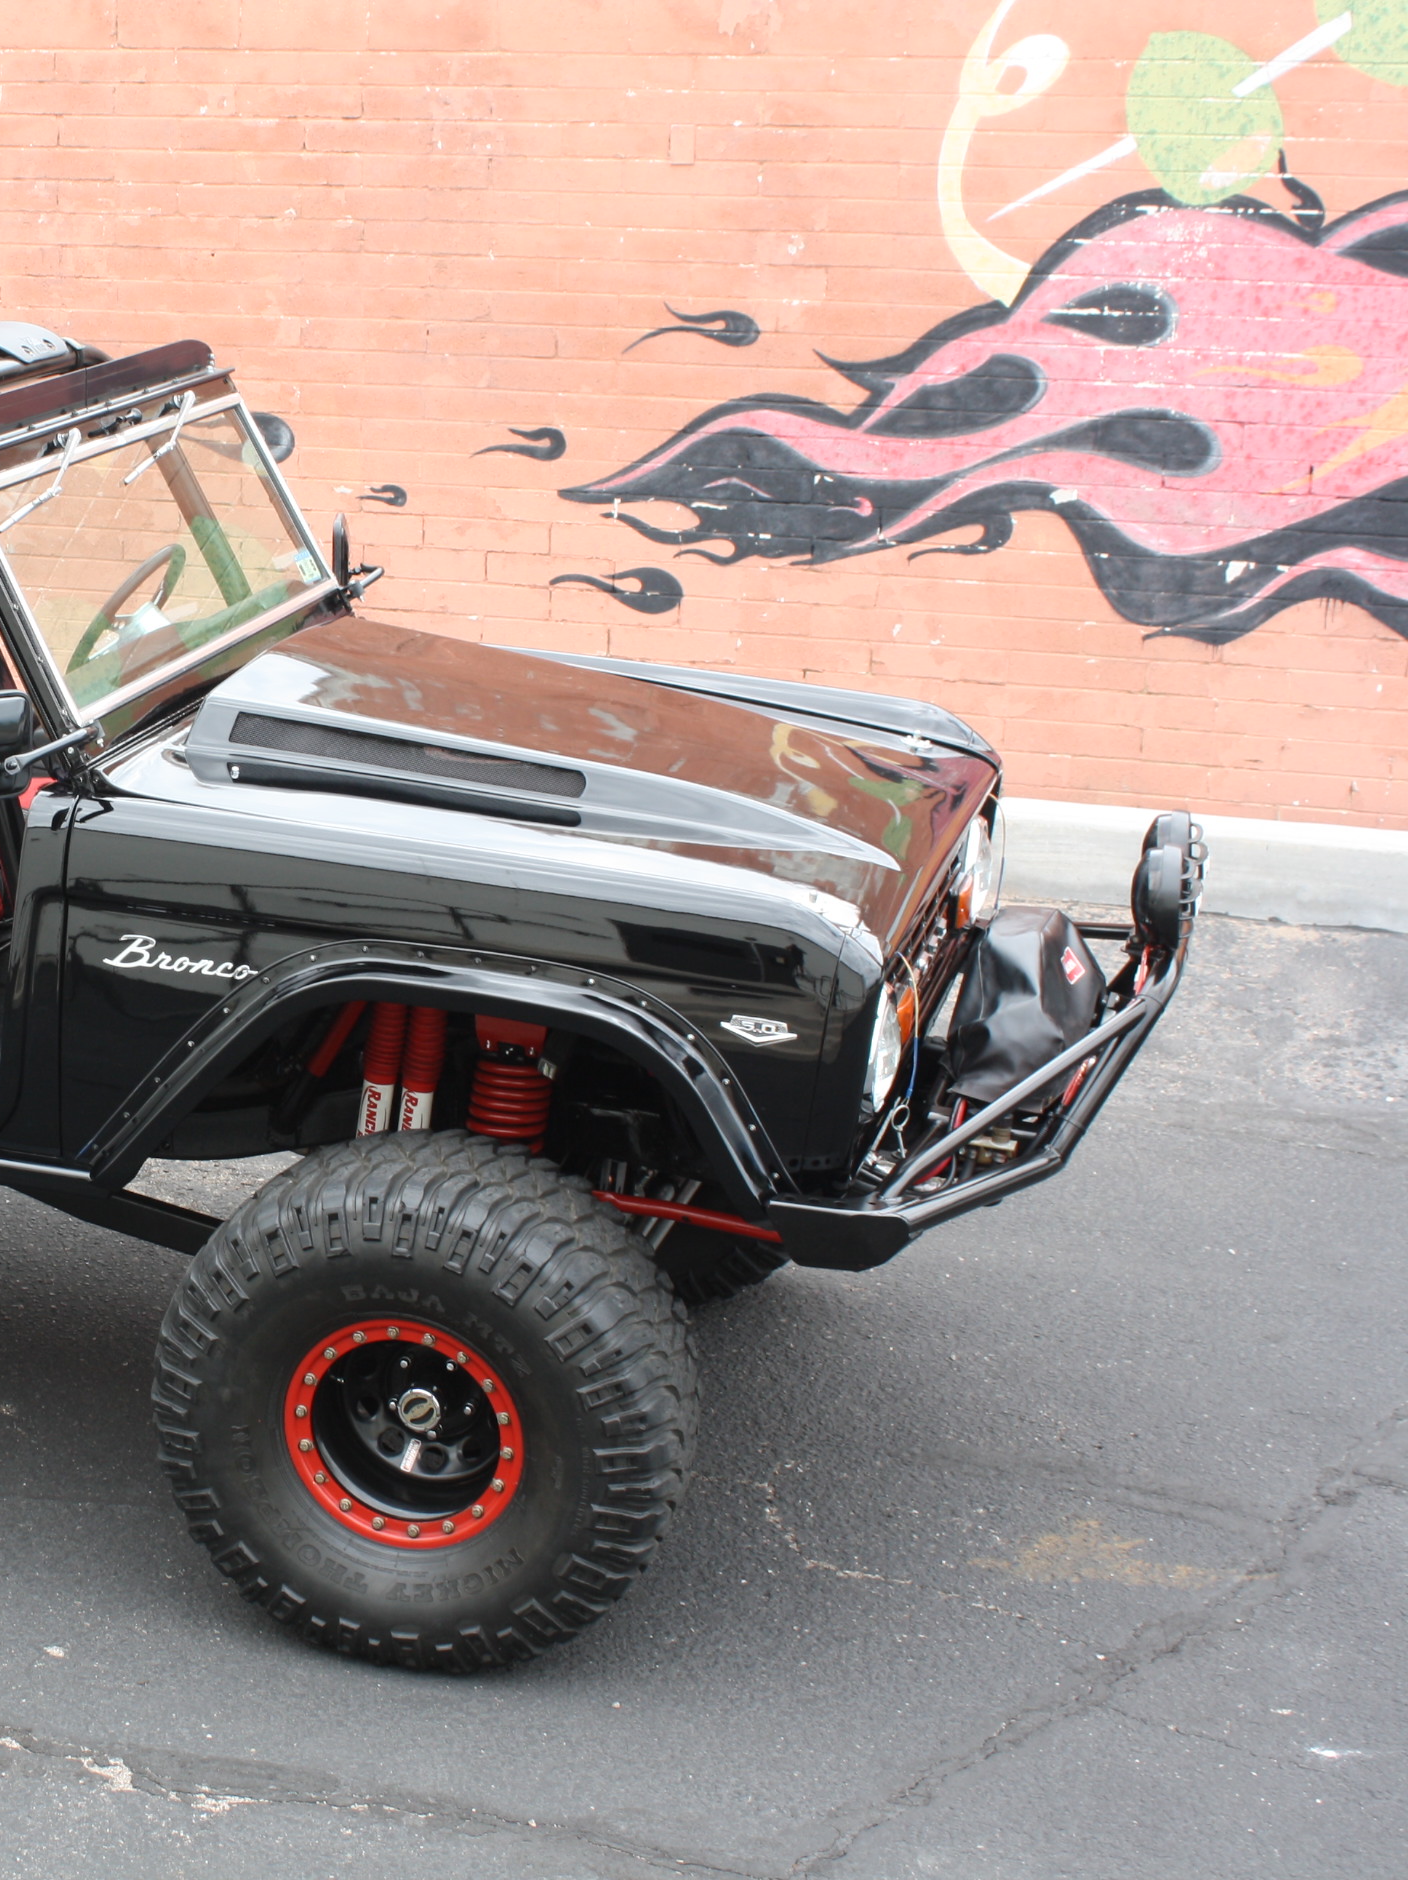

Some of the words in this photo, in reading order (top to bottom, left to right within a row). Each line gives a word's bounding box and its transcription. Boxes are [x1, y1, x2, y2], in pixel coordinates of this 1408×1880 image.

[103, 934, 258, 980] Bronco
[341, 1284, 445, 1313] BAJA
[230, 1425, 368, 1595] THOMPSON
[385, 1546, 525, 1603] MICKEY
